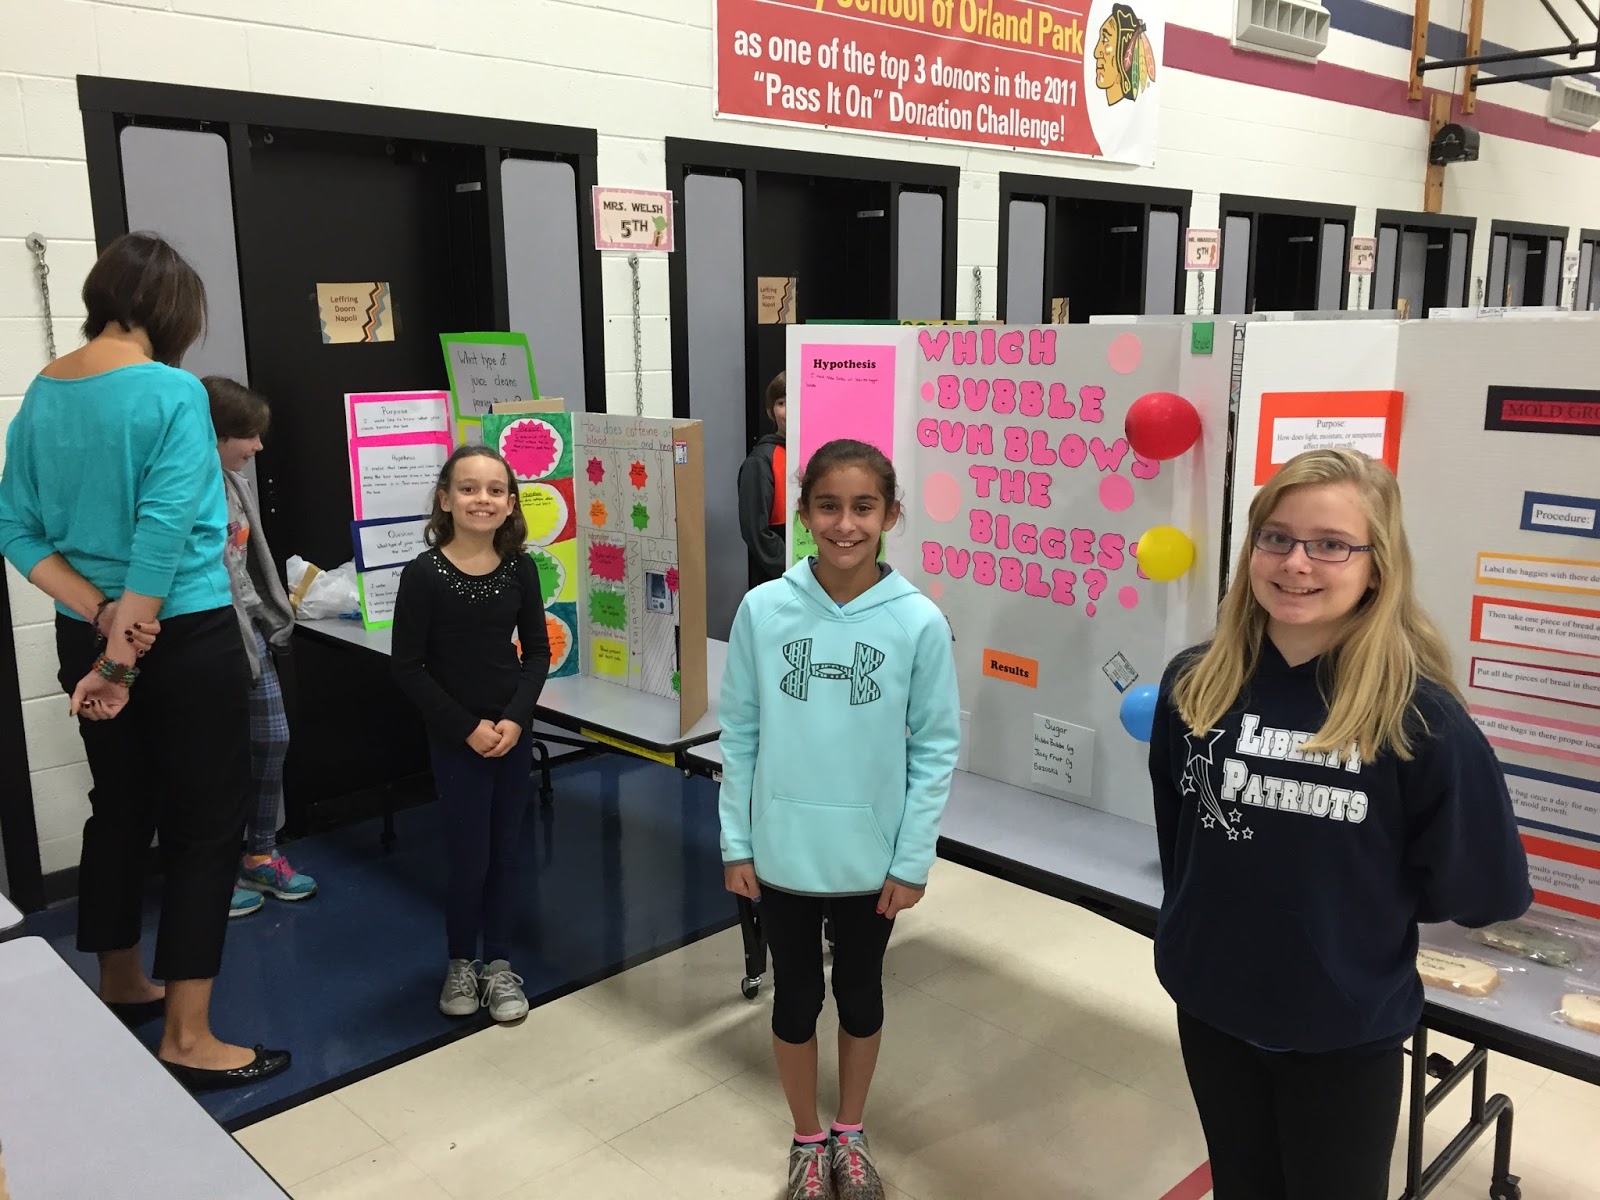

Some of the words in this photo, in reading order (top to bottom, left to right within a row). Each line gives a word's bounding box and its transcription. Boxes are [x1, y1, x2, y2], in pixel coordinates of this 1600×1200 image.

[931, 0, 954, 29] of
[959, 0, 1033, 44] Orland
[1039, 11, 1084, 55] Park
[734, 30, 762, 58] as
[768, 36, 812, 66] one
[818, 37, 840, 70] of
[843, 41, 876, 76] the
[880, 50, 910, 89] top
[914, 54, 926, 84] 3
[930, 56, 991, 94] donors
[994, 67, 1010, 97] in
[1014, 71, 1042, 101] the
[1044, 76, 1077, 107] 2011
[827, 81, 841, 115] It
[889, 91, 972, 131] Donation
[976, 104, 1065, 147] Challenge!
[603, 201, 627, 211] MRS.
[632, 203, 664, 214] WELSH
[621, 219, 648, 239] 5TH
[918, 328, 1057, 365] WHICH
[457, 350, 477, 365] What
[481, 353, 497, 370] type
[813, 359, 877, 370] Hypothesis
[494, 374, 517, 387] cleans
[937, 374, 1106, 424] BUBBLE
[1508, 404, 1562, 418] MOLD
[917, 417, 994, 455] GUM
[1277, 433, 1290, 441] How
[1291, 433, 1304, 441] does
[1303, 442, 1319, 450] affect
[969, 464, 1052, 508] THE
[1535, 509, 1590, 524] Procedure:
[969, 508, 1151, 580] BIGGES
[921, 541, 1108, 618] BUBBLE?
[1484, 565, 1505, 574] Label
[1507, 567, 1518, 575] the
[1520, 568, 1548, 579] baggies
[1551, 571, 1567, 580] with
[1569, 573, 1588, 582] there
[1488, 610, 1506, 619] Then
[1508, 613, 1523, 622] take
[1540, 618, 1560, 627] piece
[1573, 621, 1594, 630] bread
[1514, 624, 1534, 632] water
[1547, 627, 1553, 635] it
[1555, 629, 1567, 637] for
[990, 659, 1030, 679] Results
[1477, 667, 1489, 675] Put
[1502, 671, 1513, 679] the
[1515, 673, 1538, 682] pieces
[1540, 676, 1549, 684] of
[1549, 678, 1571, 687] bread
[1573, 681, 1581, 689] in
[1044, 719, 1067, 738] Sugar
[1487, 720, 1496, 728] all
[1497, 722, 1509, 731] the
[1511, 724, 1528, 736] bags
[1529, 728, 1537, 736] in
[1538, 731, 1557, 741] there
[1558, 735, 1583, 747] proper
[1221, 758, 1368, 824] PATRIOTS
[1515, 788, 1528, 799] bag
[1530, 793, 1548, 802] once
[1555, 798, 1569, 808] day
[1571, 802, 1583, 810] for
[1584, 806, 1598, 815] any
[1520, 800, 1539, 810] mold
[1533, 874, 1552, 884] mold
[1553, 869, 1586, 884] everyday
